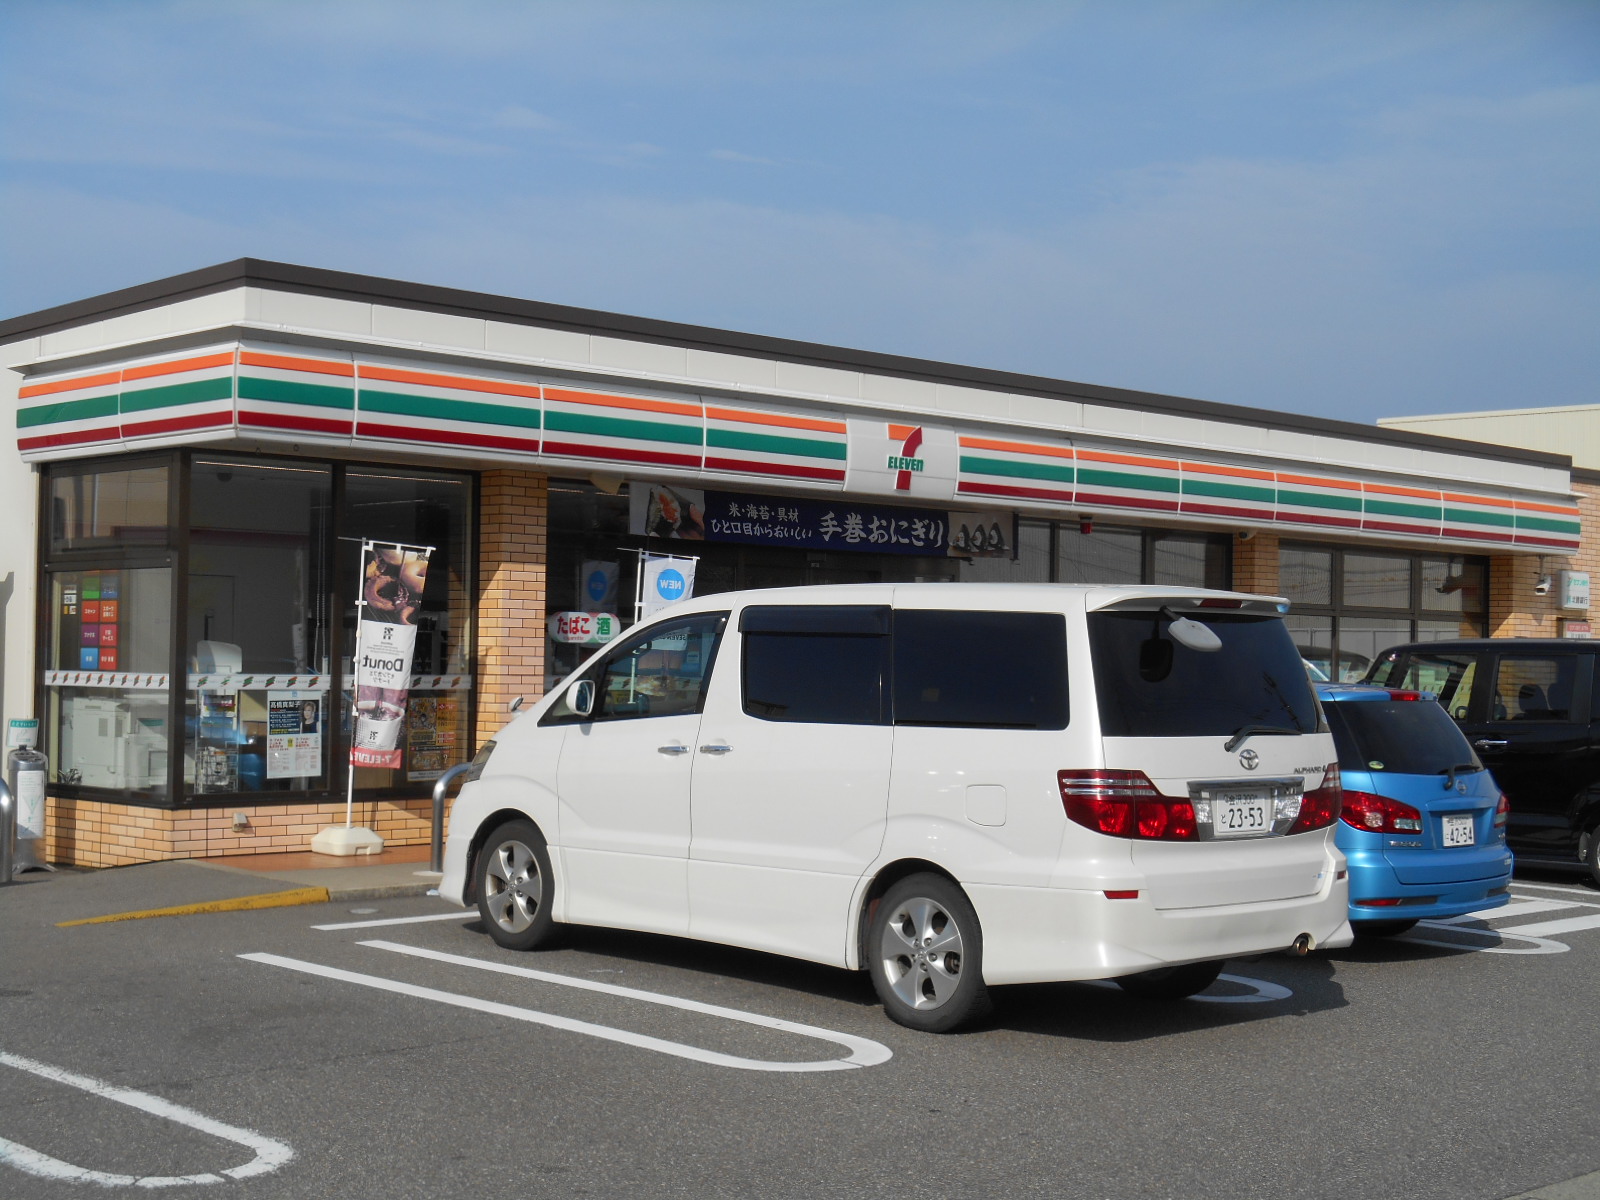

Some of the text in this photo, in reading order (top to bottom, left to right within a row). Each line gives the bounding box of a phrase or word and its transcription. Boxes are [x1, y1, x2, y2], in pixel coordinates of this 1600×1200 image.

[887, 423, 923, 491] 7
[728, 502, 799, 523] 米・海苔・具材
[710, 519, 812, 540] ひと口目からおいしい
[819, 510, 944, 547] 手巻おにぎり
[556, 615, 591, 635] たばこ
[596, 617, 611, 635] 酒
[1221, 814, 1227, 824] と
